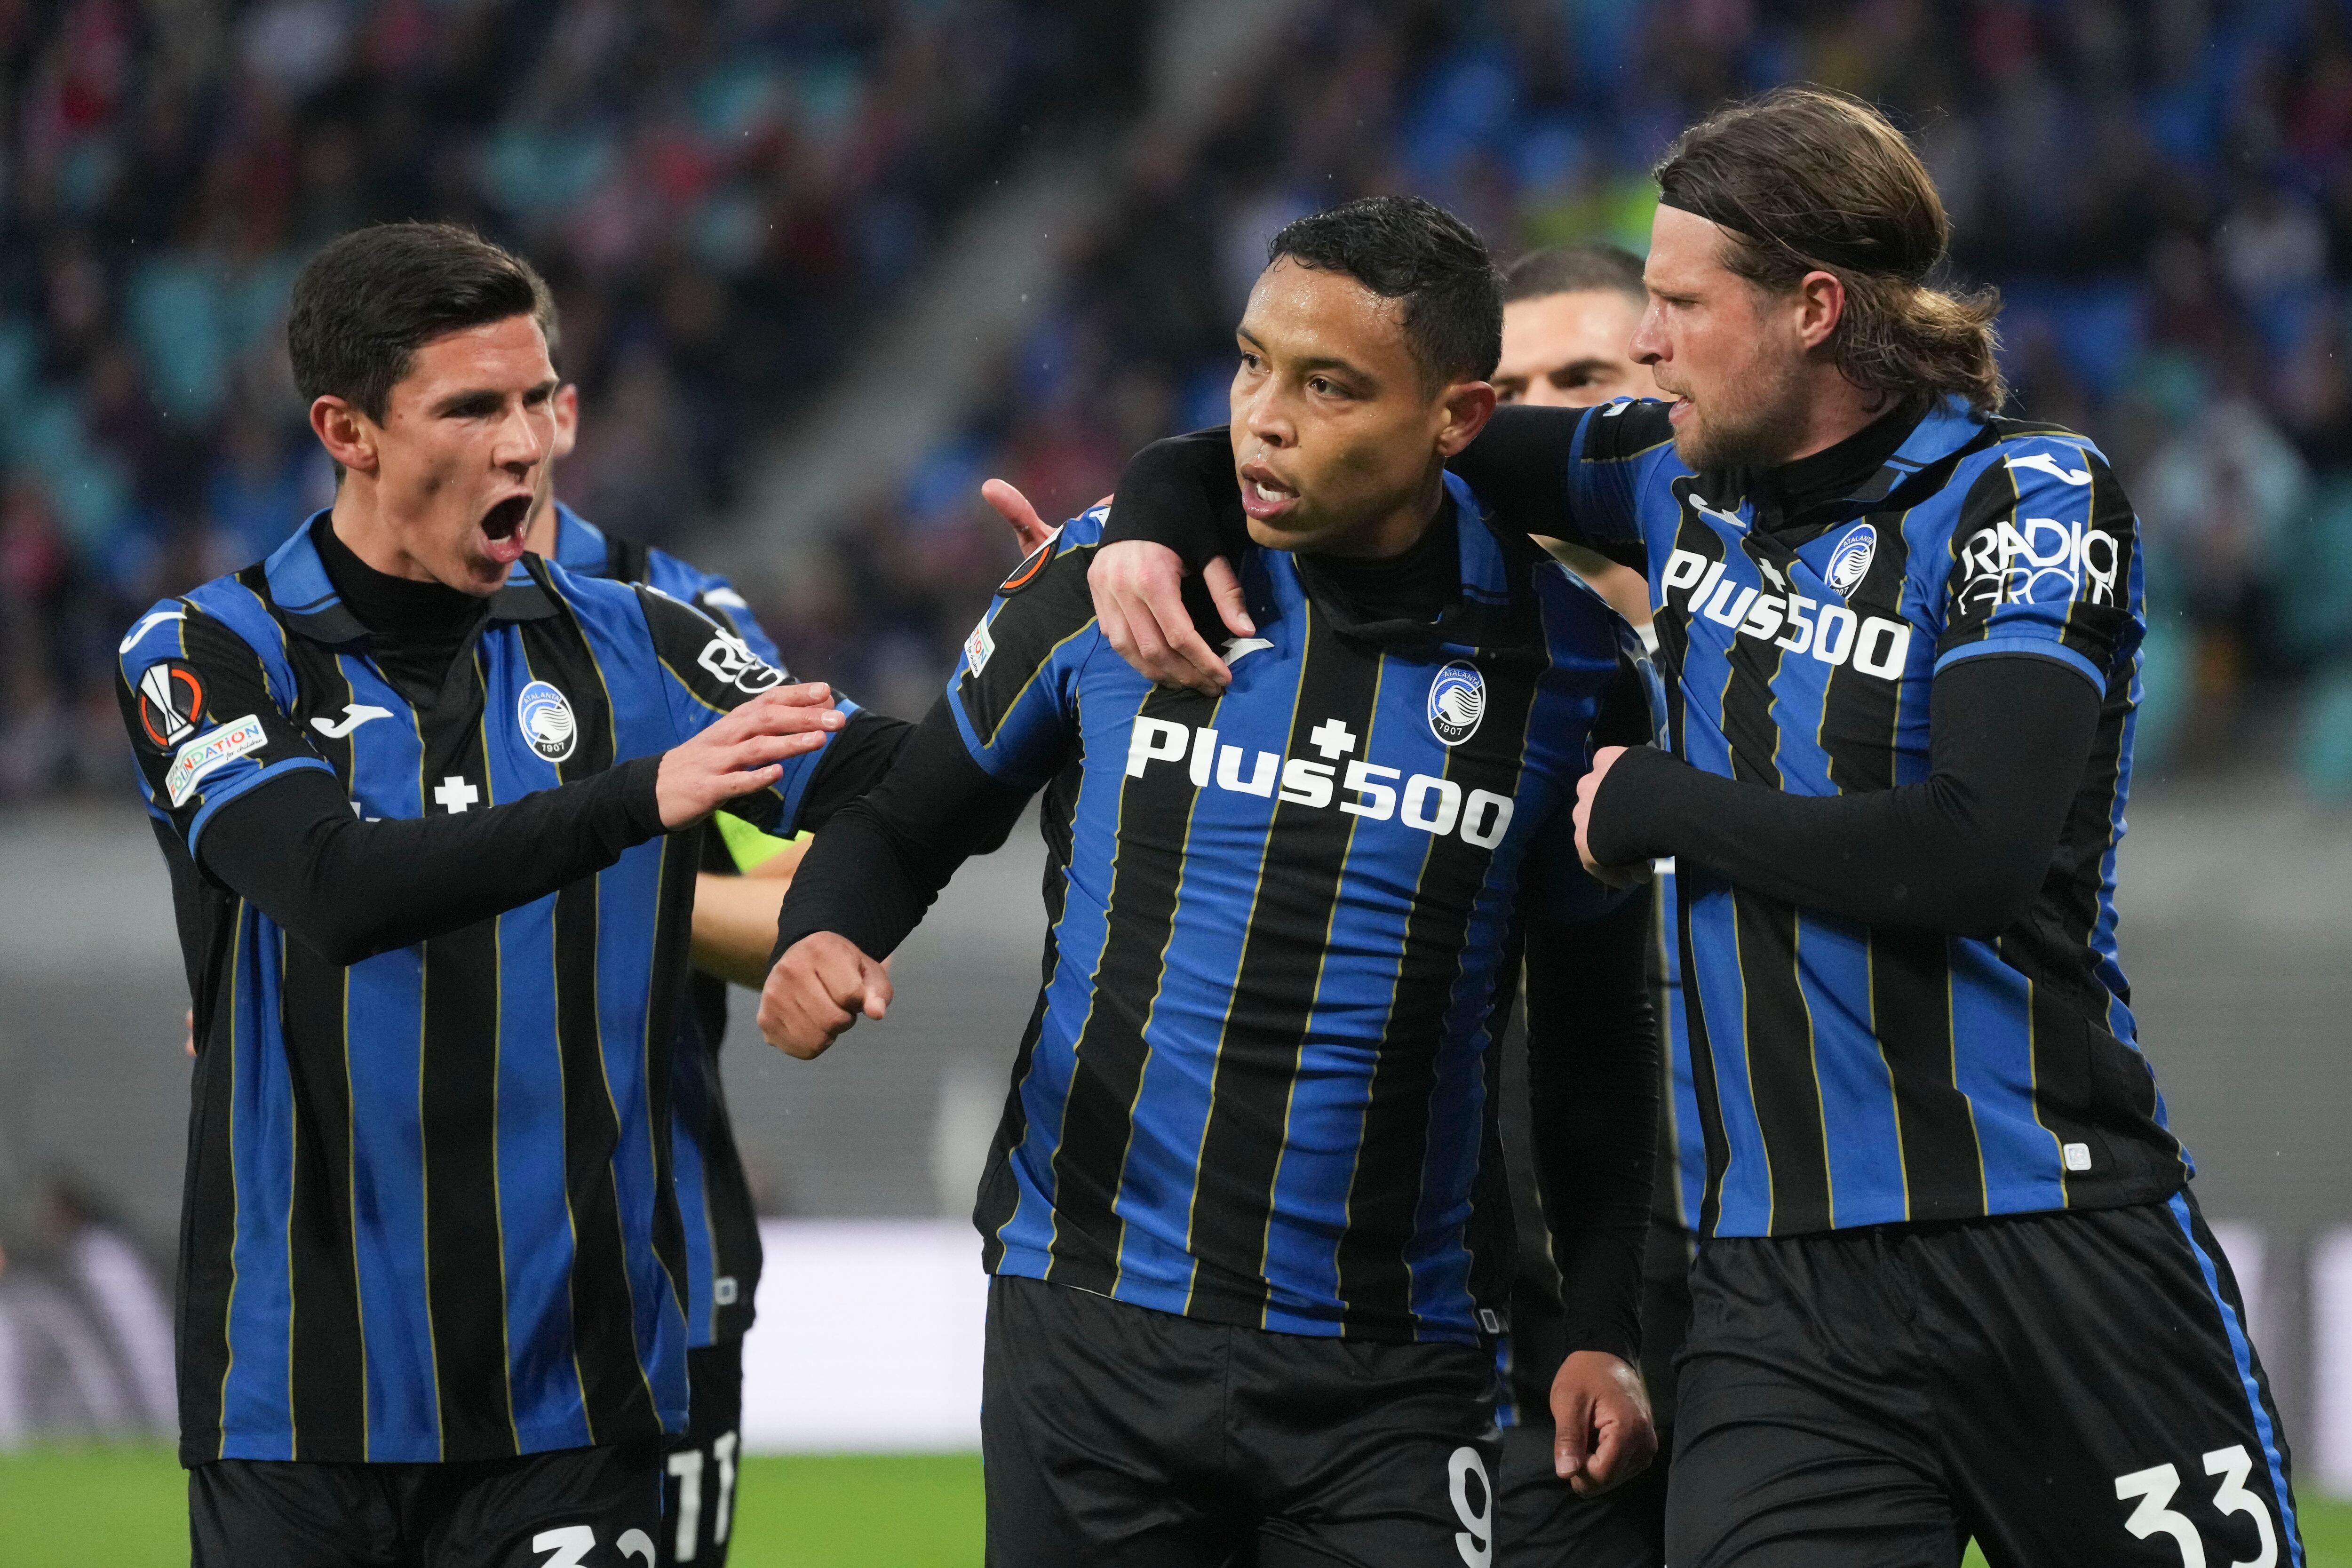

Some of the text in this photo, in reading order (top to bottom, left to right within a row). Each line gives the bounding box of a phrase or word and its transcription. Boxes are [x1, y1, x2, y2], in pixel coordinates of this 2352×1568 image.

[1843, 535, 1874, 547] ATALANTA
[1661, 549, 1912, 681] Plus500
[524, 692, 561, 704] ATALANTA
[1444, 670, 1480, 687] ATALANTA
[237, 738, 262, 753] children
[542, 742, 564, 752] 1907
[1439, 723, 1462, 735] 1907
[170, 724, 259, 799] FOUNDATION
[1126, 715, 1514, 850] Plus500
[667, 1431, 737, 1562] 11
[1448, 1446, 1492, 1568] 9
[2114, 1444, 2278, 1568] 33
